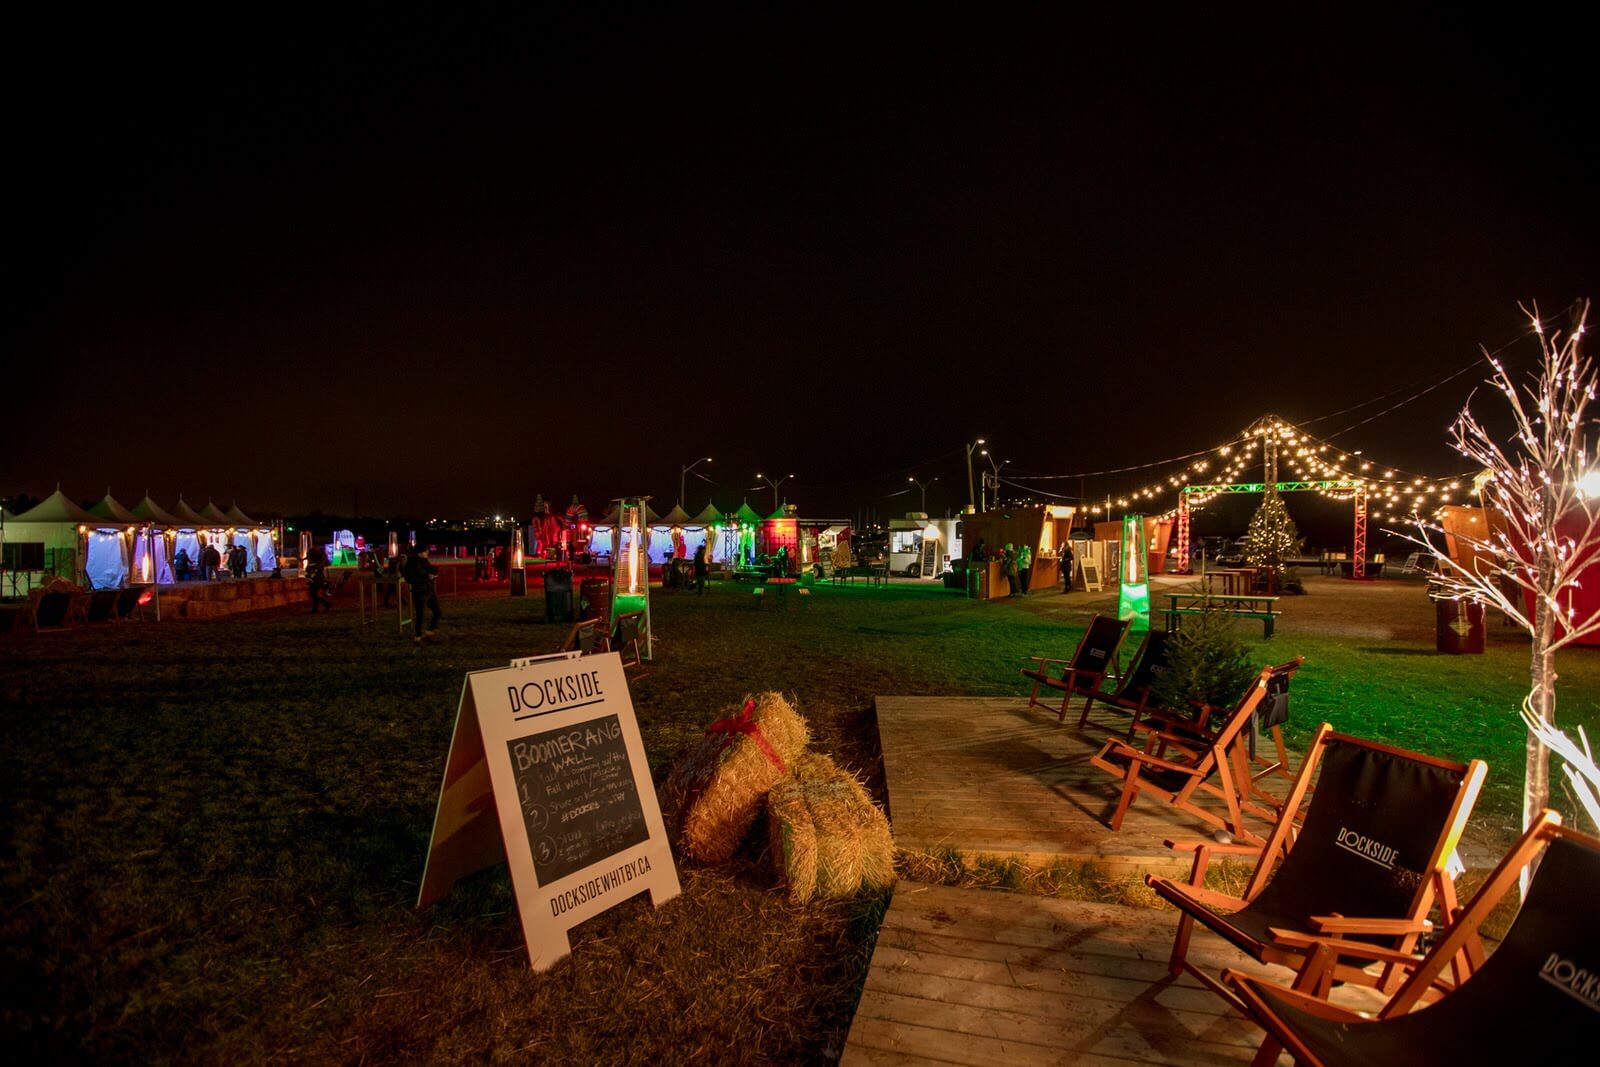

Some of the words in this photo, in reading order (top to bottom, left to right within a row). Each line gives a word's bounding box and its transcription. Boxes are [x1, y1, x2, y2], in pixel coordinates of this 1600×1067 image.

[507, 671, 603, 713] DOCKSIDE
[513, 721, 621, 770] BOOMERANG
[551, 752, 593, 773] WALL
[1337, 826, 1400, 867] DOCKSIDE
[550, 855, 652, 918] DOCKSIDEWHITBY.CA
